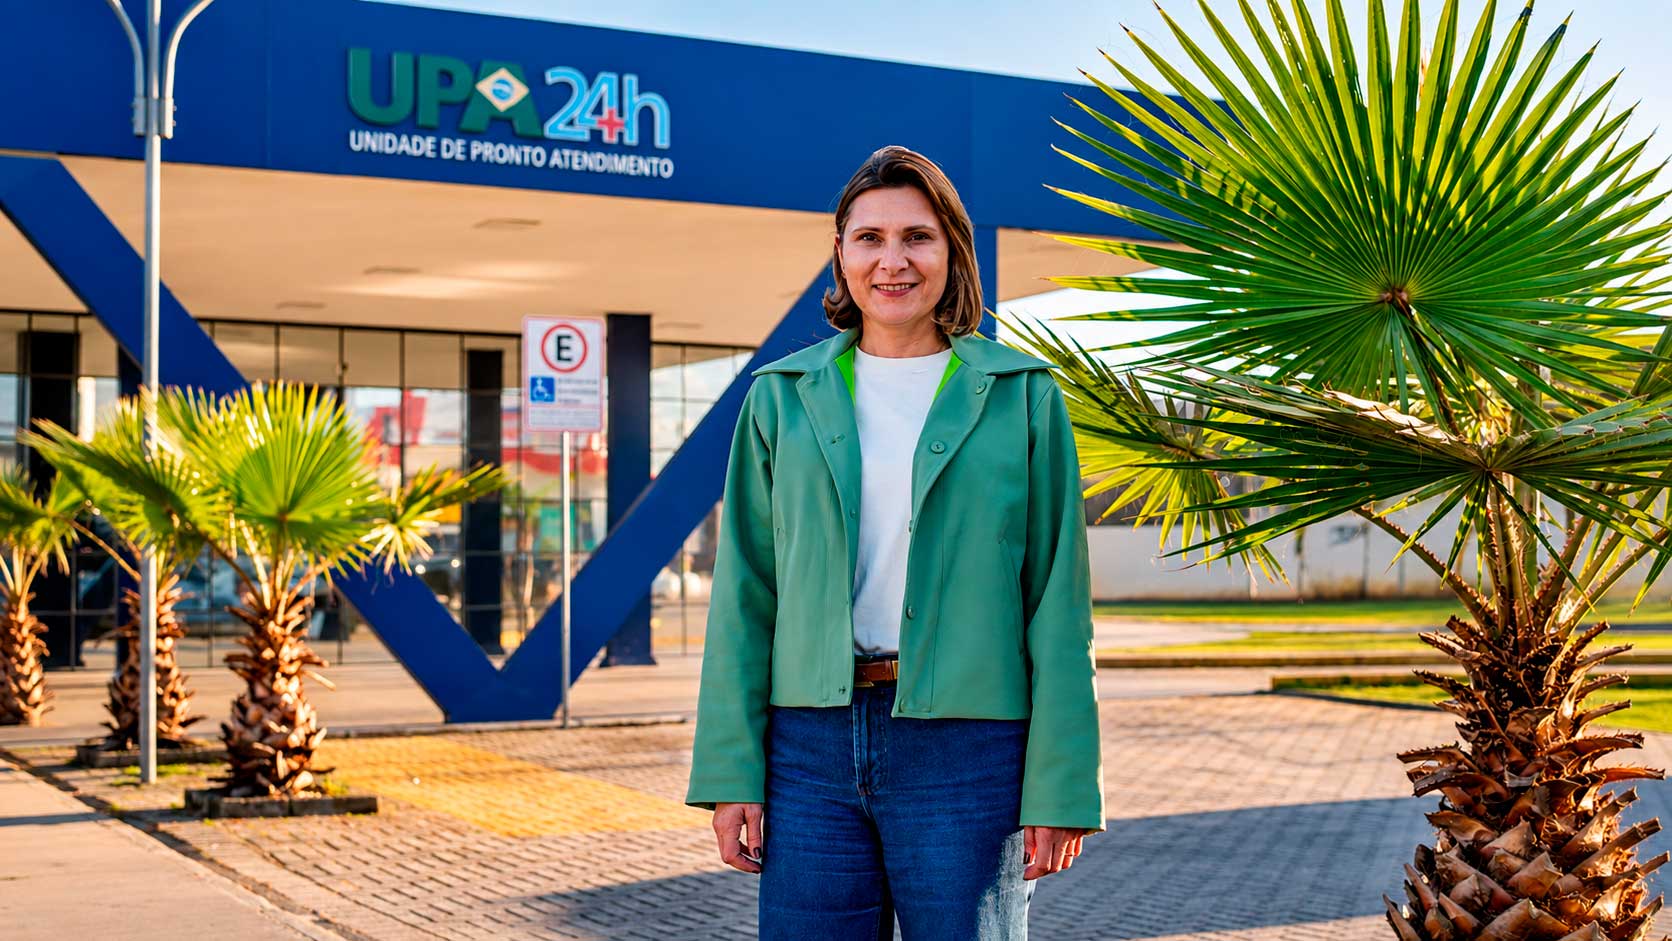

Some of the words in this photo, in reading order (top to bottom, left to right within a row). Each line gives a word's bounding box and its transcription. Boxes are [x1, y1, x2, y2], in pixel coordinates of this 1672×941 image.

[347, 47, 544, 138] UPA
[544, 66, 671, 149] 24h
[349, 130, 437, 158] UNIDADE
[441, 138, 466, 161] DE
[470, 141, 546, 168] PRONTO
[549, 149, 674, 179] ATENDIMENTO
[556, 335, 572, 362] E
